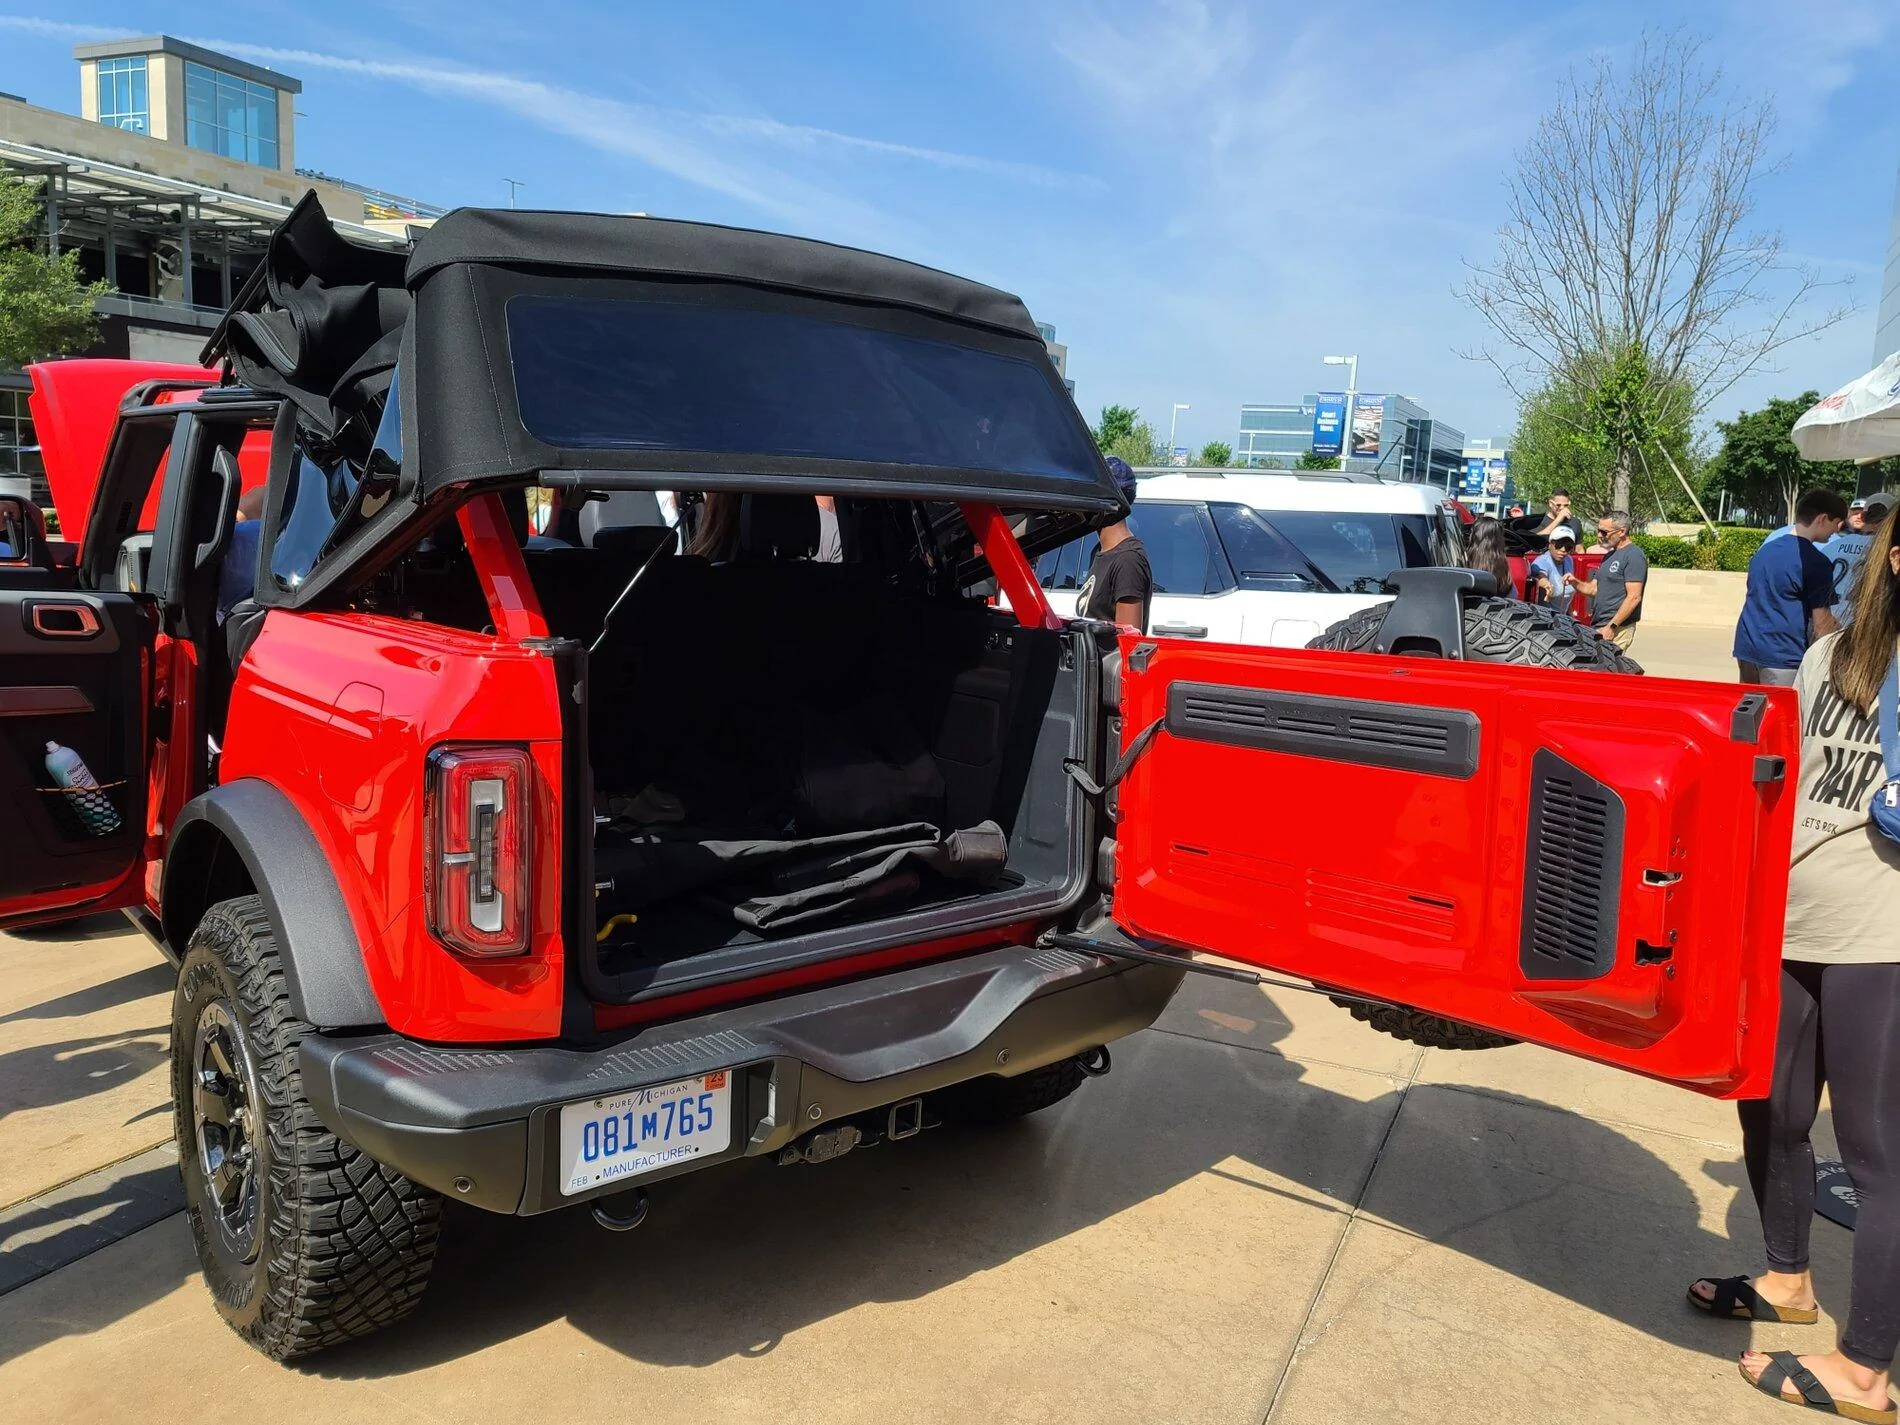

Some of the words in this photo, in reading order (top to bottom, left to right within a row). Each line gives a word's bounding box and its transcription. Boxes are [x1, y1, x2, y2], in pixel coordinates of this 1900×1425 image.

[1808, 745, 1884, 813] WAR
[710, 1070, 725, 1083] 23
[609, 1098, 632, 1111] PURE
[628, 1084, 689, 1112] MICHIGAN
[583, 1093, 713, 1163] 081M765
[602, 1144, 692, 1178] MANUFACTURER
[571, 1175, 588, 1189] FEB
